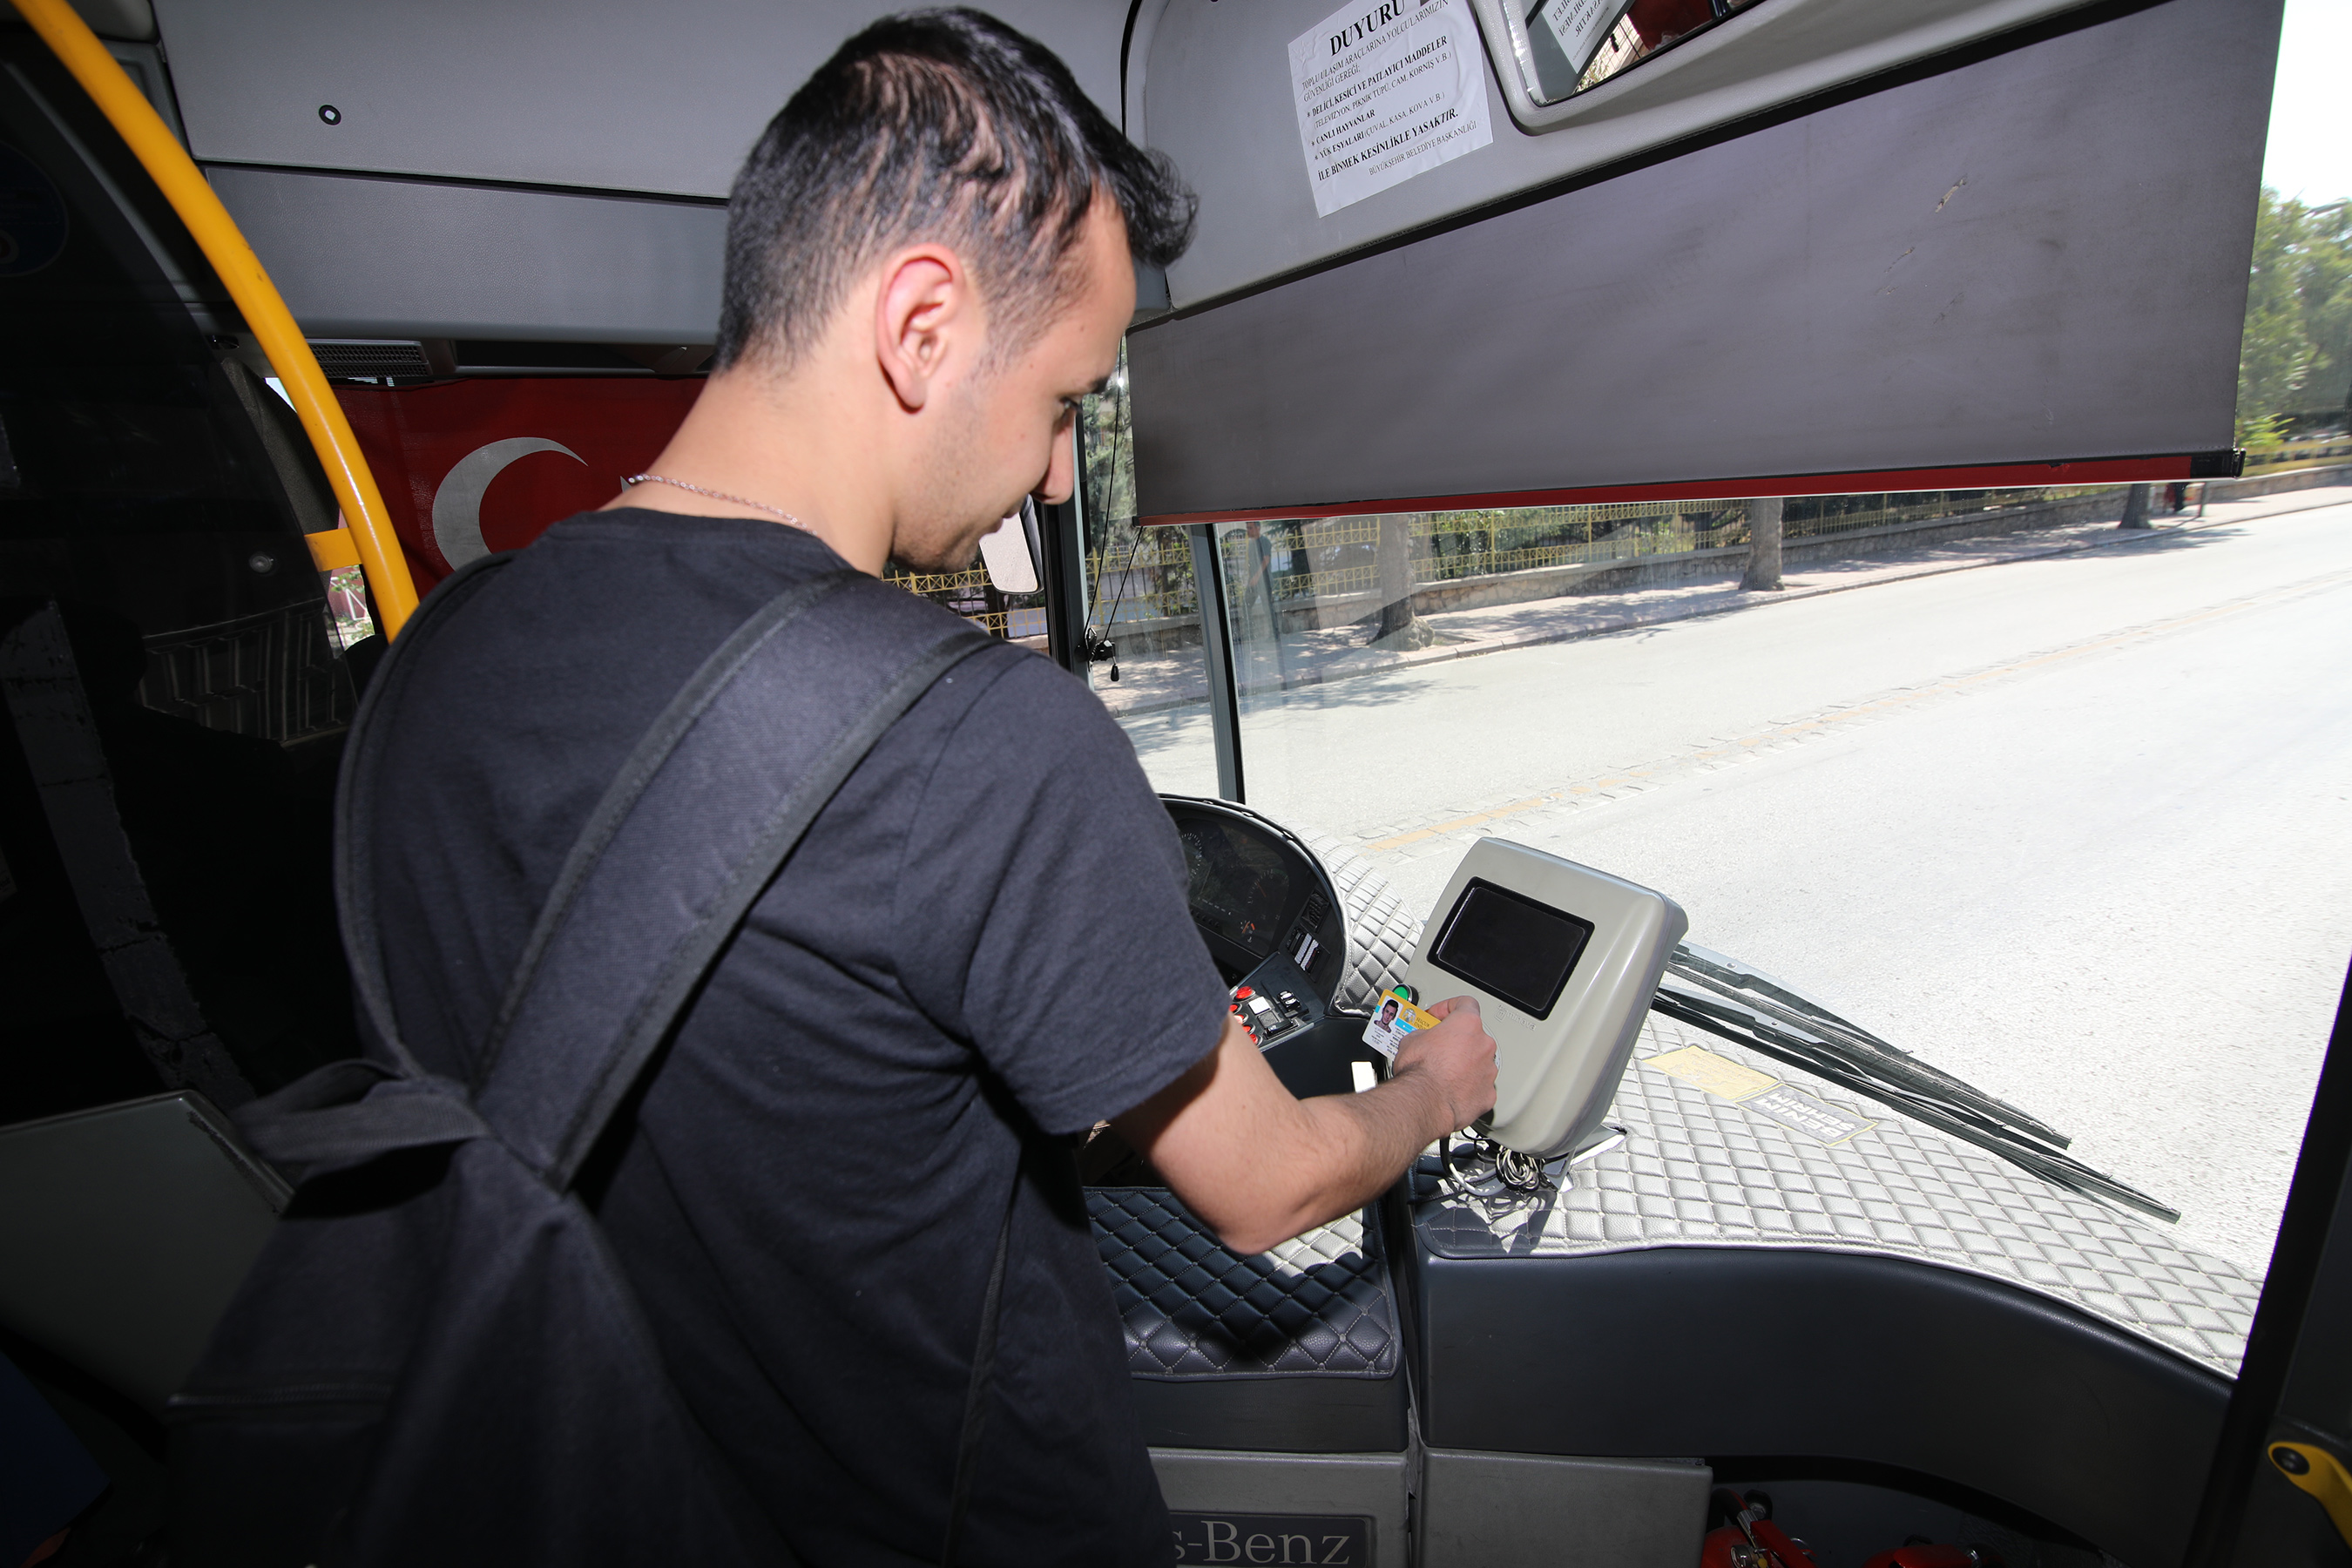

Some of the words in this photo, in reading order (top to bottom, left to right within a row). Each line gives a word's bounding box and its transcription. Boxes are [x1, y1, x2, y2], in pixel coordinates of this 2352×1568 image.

[1329, 0, 1405, 57] DUYURU
[1301, 73, 1321, 91] TOPLU
[1320, 59, 1344, 78] ULAŞIM
[1345, 35, 1387, 67] ARAÇLARINA
[1303, 77, 1335, 103] GÜVENLİĞİ
[1335, 83, 1357, 105] KESİCİ
[1357, 79, 1368, 91] VE
[1368, 60, 1403, 86] PATLAYICI
[1404, 35, 1448, 66] MADDELER
[1316, 129, 1336, 145] CANLI
[1336, 109, 1375, 135] HAYVANLAR
[1317, 167, 1330, 181] İLE
[1331, 154, 1359, 175] BİNMEK
[1361, 130, 1411, 161] KESİNLİKLE
[1412, 108, 1458, 137] YASAKTIR.
[1319, 146, 1332, 159] YÜK
[1409, 99, 1429, 114] KOVA
[1369, 152, 1406, 176] BÜYÜKŞEHİR
[1406, 139, 1436, 159] BELEDİYE
[1436, 120, 1477, 145] BAŞKANLIĞI
